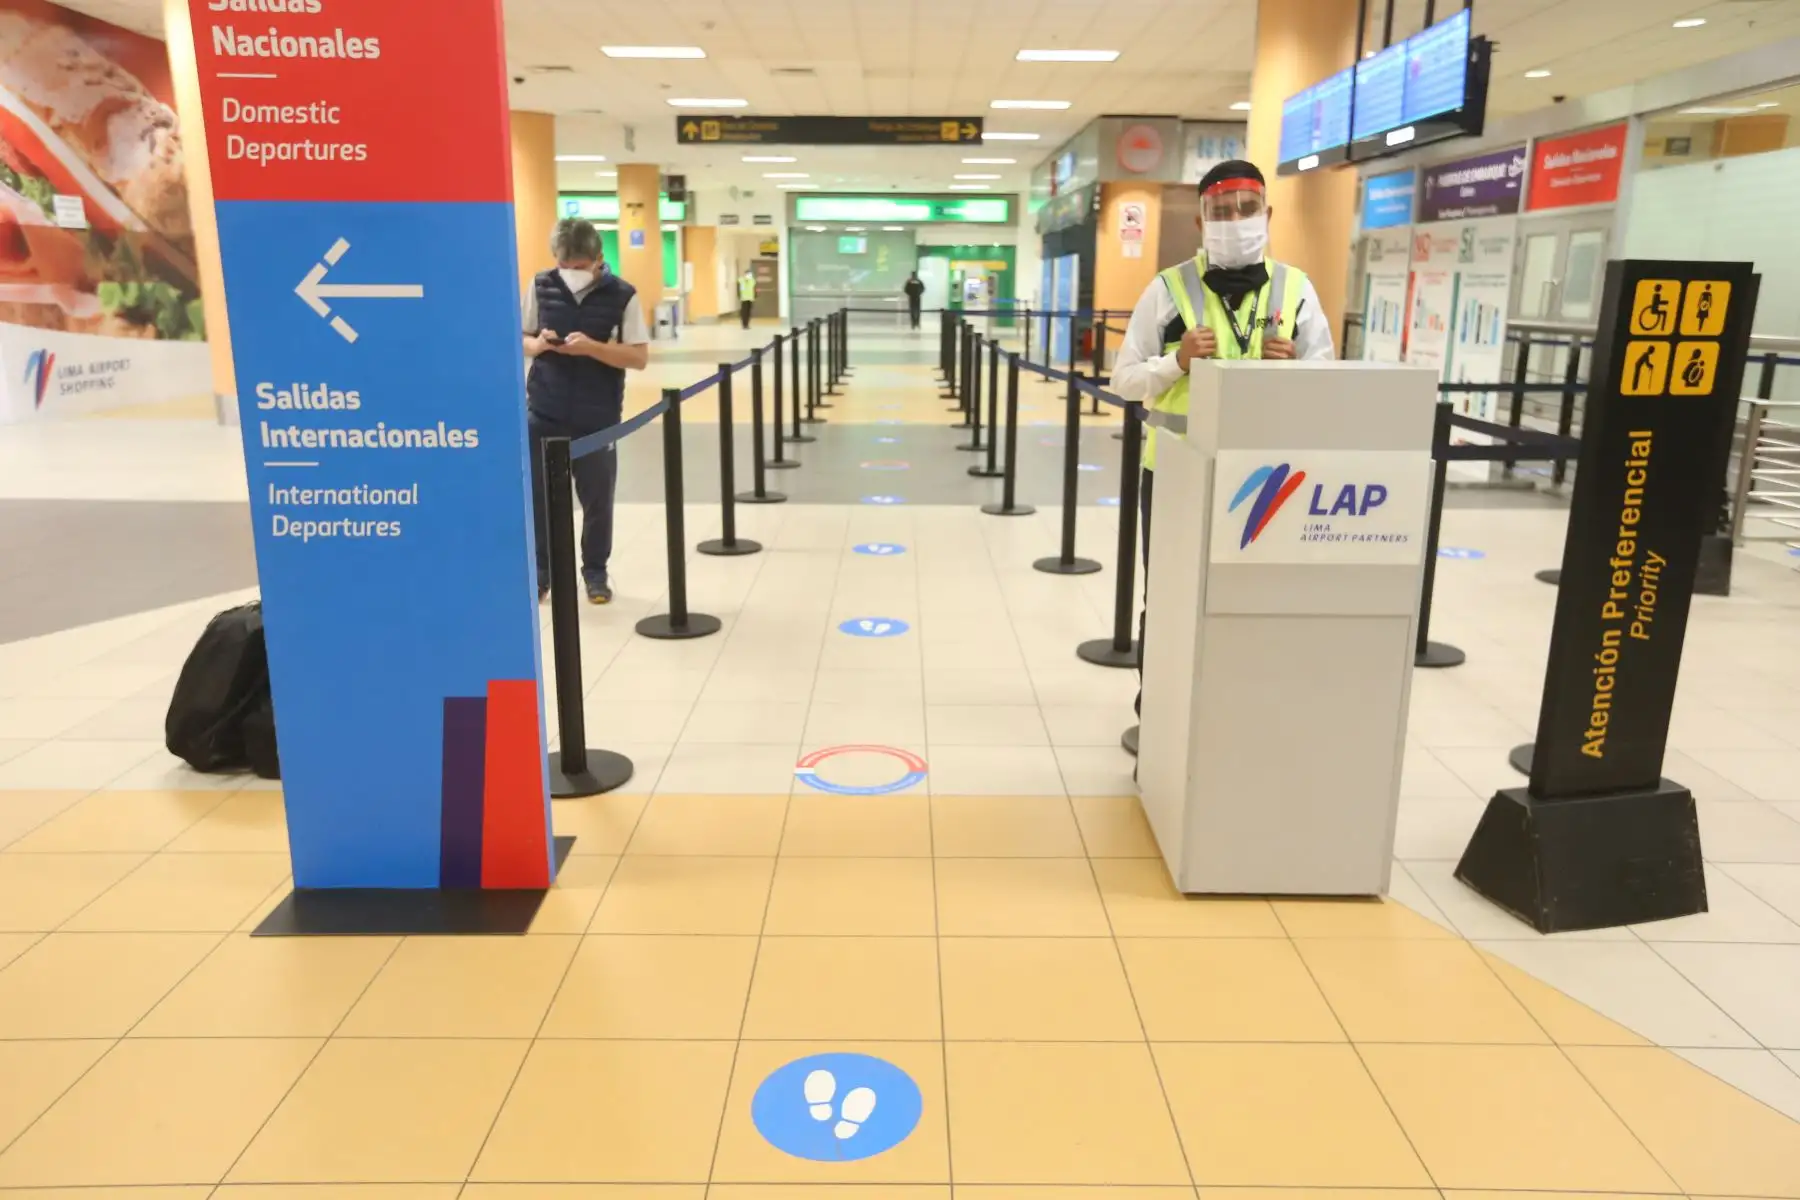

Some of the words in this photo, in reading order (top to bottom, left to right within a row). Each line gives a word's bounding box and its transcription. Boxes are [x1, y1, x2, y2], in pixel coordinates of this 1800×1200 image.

[211, 25, 381, 59] Nacionales
[222, 97, 340, 124] Domestic
[226, 134, 368, 167] Departures
[256, 382, 361, 410] Salidas
[260, 421, 479, 448] Internacionales
[268, 483, 418, 505] International
[1308, 484, 1387, 516] LAP
[272, 515, 401, 543] Departures
[1300, 533, 1348, 542] AIRPORT
[1351, 533, 1409, 543] PARTNERS
[1303, 524, 1331, 532] LIMA
[1601, 430, 1653, 620] Preferencial
[1630, 550, 1667, 640] Priority
[1581, 627, 1622, 759] Atención
